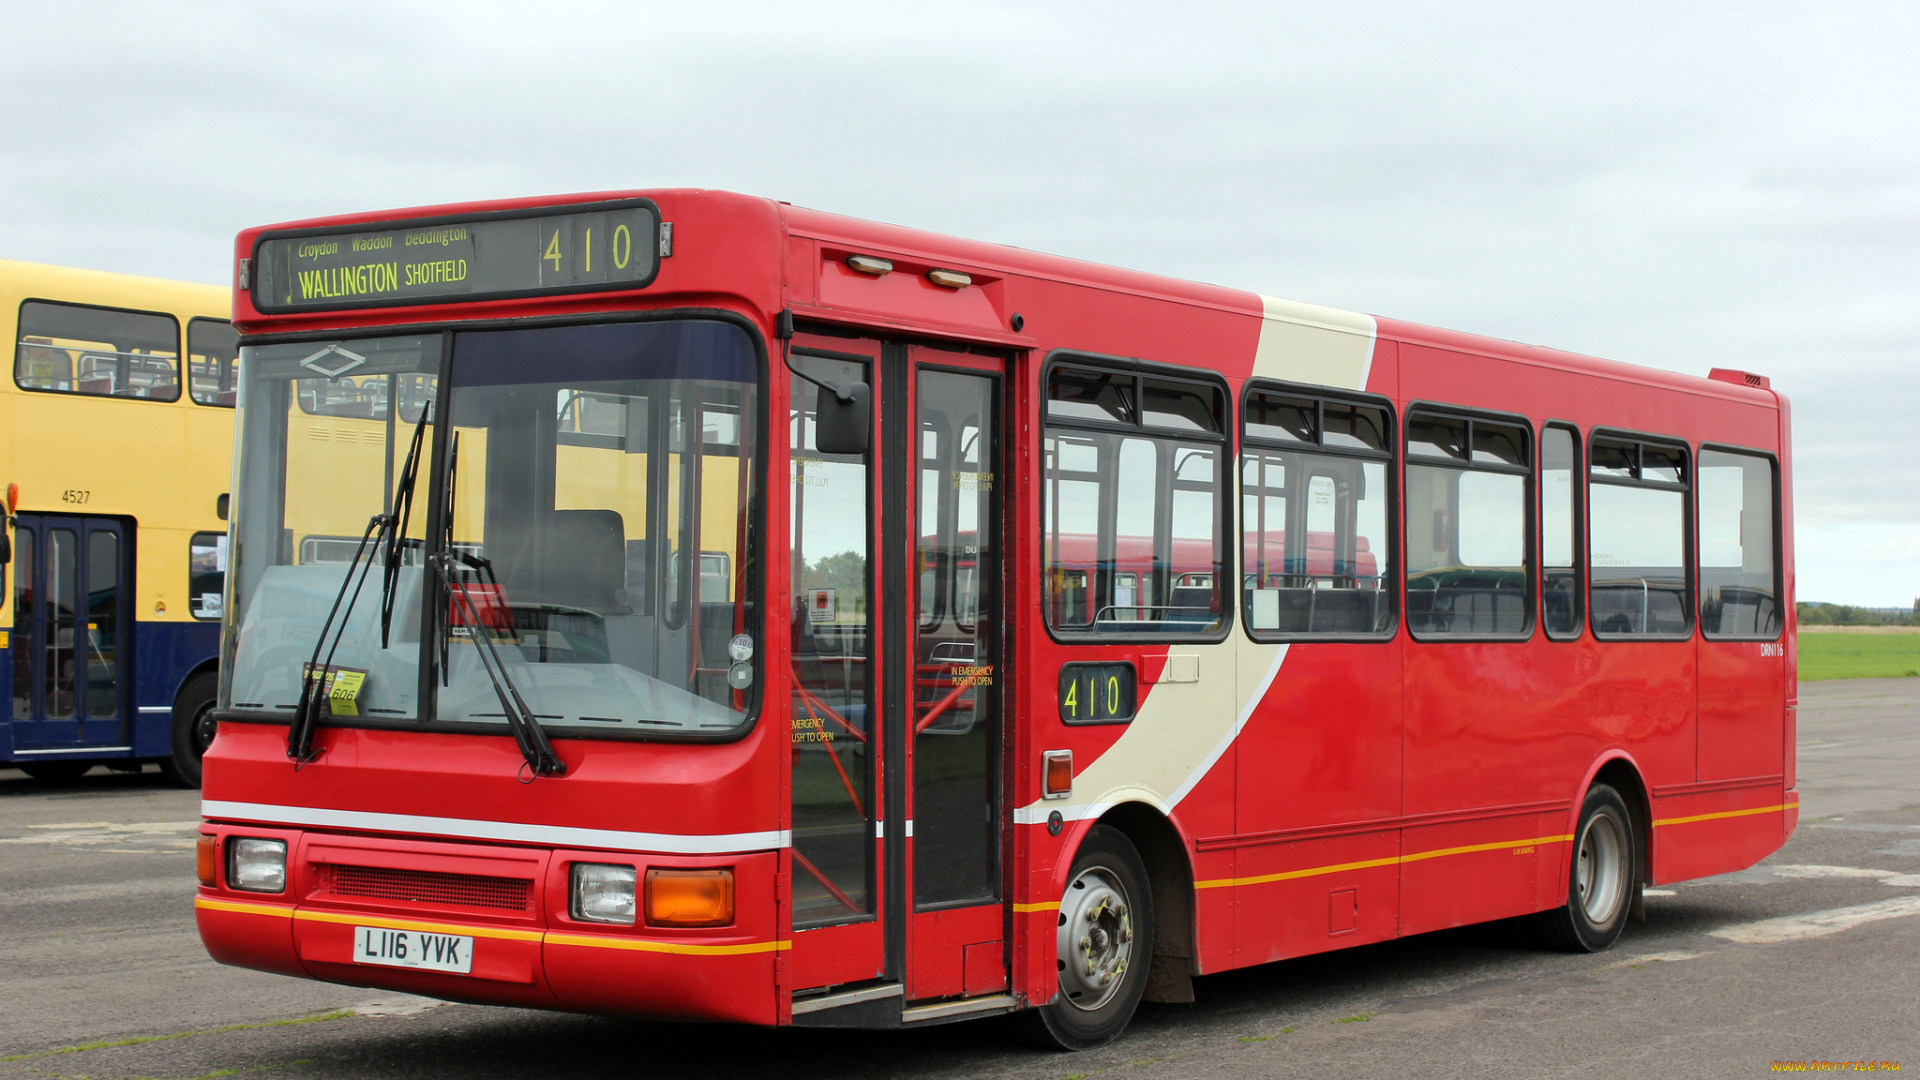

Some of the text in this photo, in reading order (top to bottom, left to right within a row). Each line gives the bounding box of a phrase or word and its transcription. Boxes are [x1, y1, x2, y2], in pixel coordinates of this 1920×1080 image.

[298, 228, 467, 261] Croydon Waddon Beddington
[543, 224, 631, 271] 410
[298, 259, 467, 299] WALLINGTON SHOTFIELD
[62, 490, 91, 504] 4527
[1760, 643, 1784, 657] DRN116
[951, 666, 994, 676] IN EMERGENCY
[952, 676, 993, 686] PUSH TO OPEN
[332, 688, 356, 701] 606
[1064, 676, 1119, 717] 410
[791, 732, 834, 743] USH TO OPEN
[366, 930, 461, 965] L116 YVK
